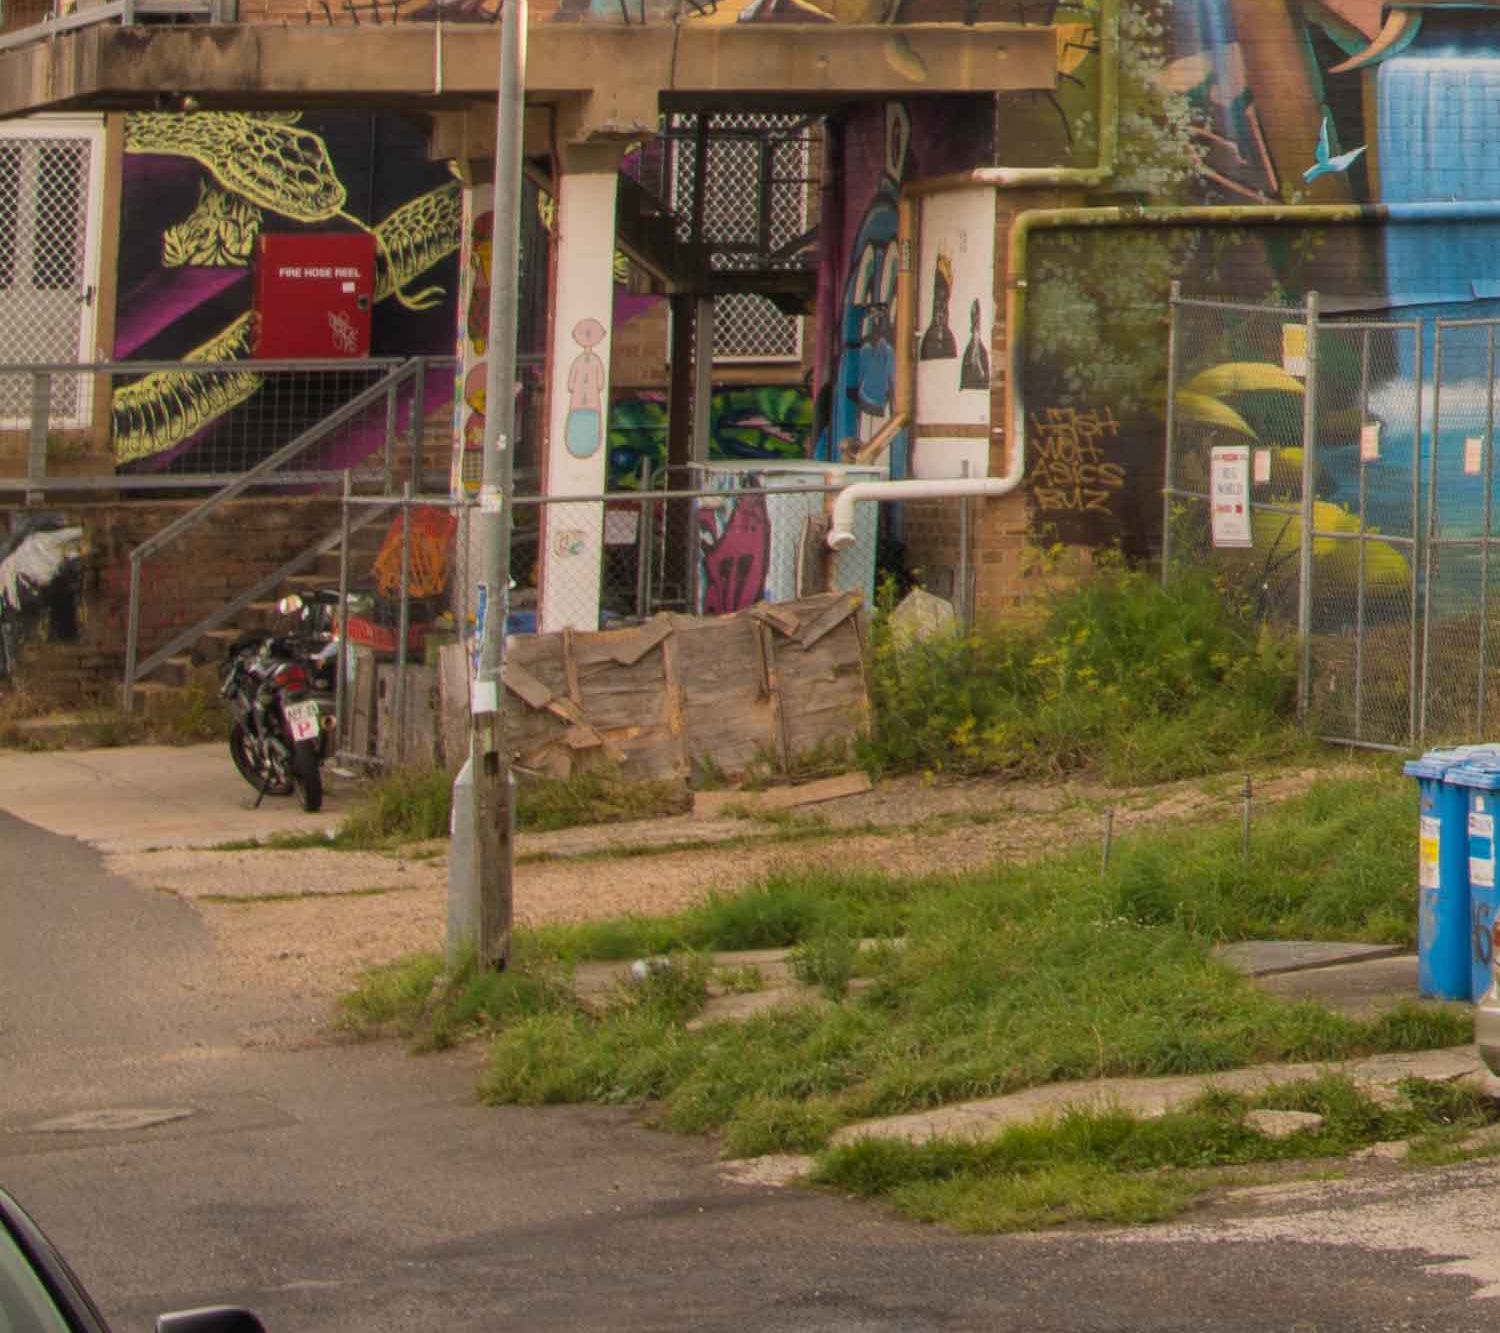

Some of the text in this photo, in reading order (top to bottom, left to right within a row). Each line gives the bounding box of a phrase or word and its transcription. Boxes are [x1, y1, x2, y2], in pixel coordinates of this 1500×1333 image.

[279, 267, 361, 278] FIRE HOSE REEL
